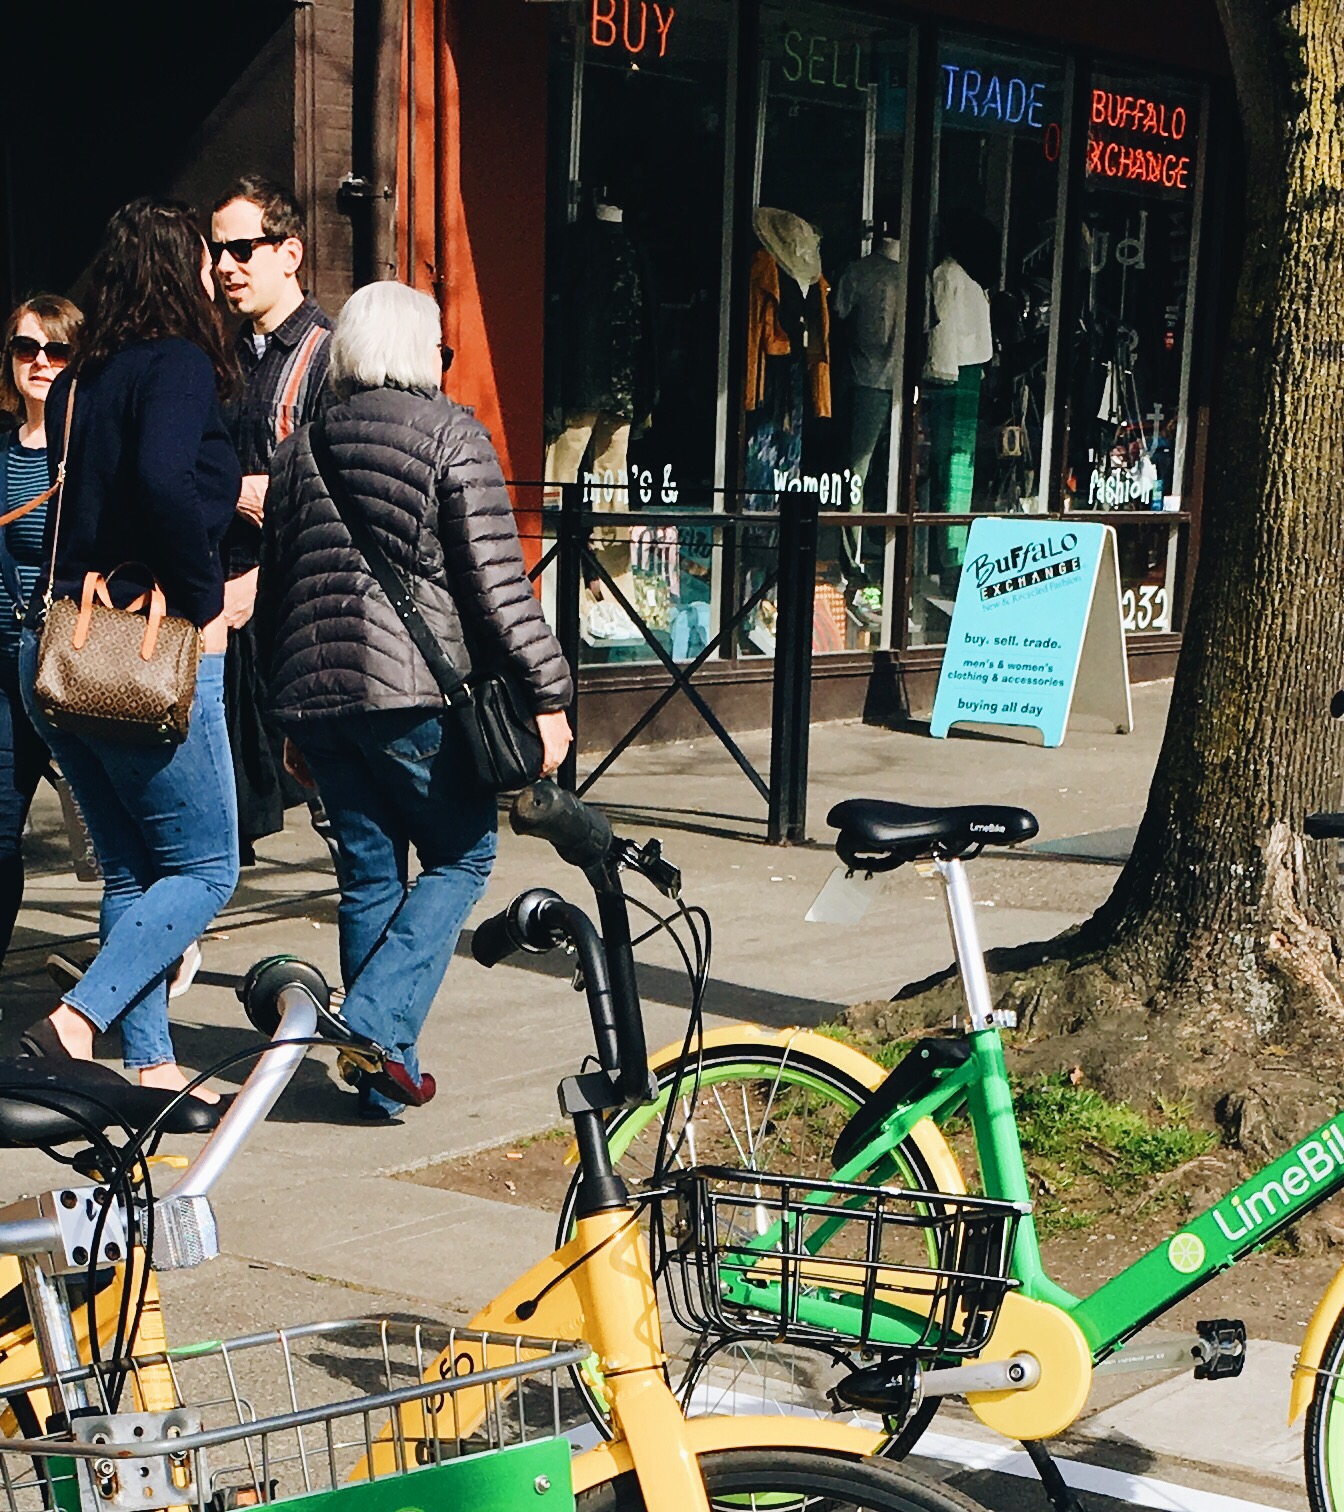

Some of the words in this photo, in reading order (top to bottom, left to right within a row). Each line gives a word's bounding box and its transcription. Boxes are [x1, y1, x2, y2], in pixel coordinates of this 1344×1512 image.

[591, 0, 674, 57] BUY
[783, 31, 869, 92] SELL
[941, 65, 1045, 127] TRADE
[1092, 90, 1186, 140] BUFFALO
[1088, 139, 1190, 188] XCHANGE
[1088, 469, 1151, 510] fashion
[981, 558, 1081, 600] EXCHANGE
[964, 632, 989, 647] buy.
[994, 635, 1019, 646] sell.
[1023, 638, 1062, 649] trade.
[947, 670, 989, 684] clothing
[991, 673, 998, 682] &
[1001, 676, 1064, 687] accessories
[963, 659, 994, 669] men's
[997, 660, 1004, 669] &
[1007, 663, 1053, 673] women's
[957, 698, 998, 714] buying
[1001, 702, 1017, 713] all
[1021, 703, 1043, 717] day
